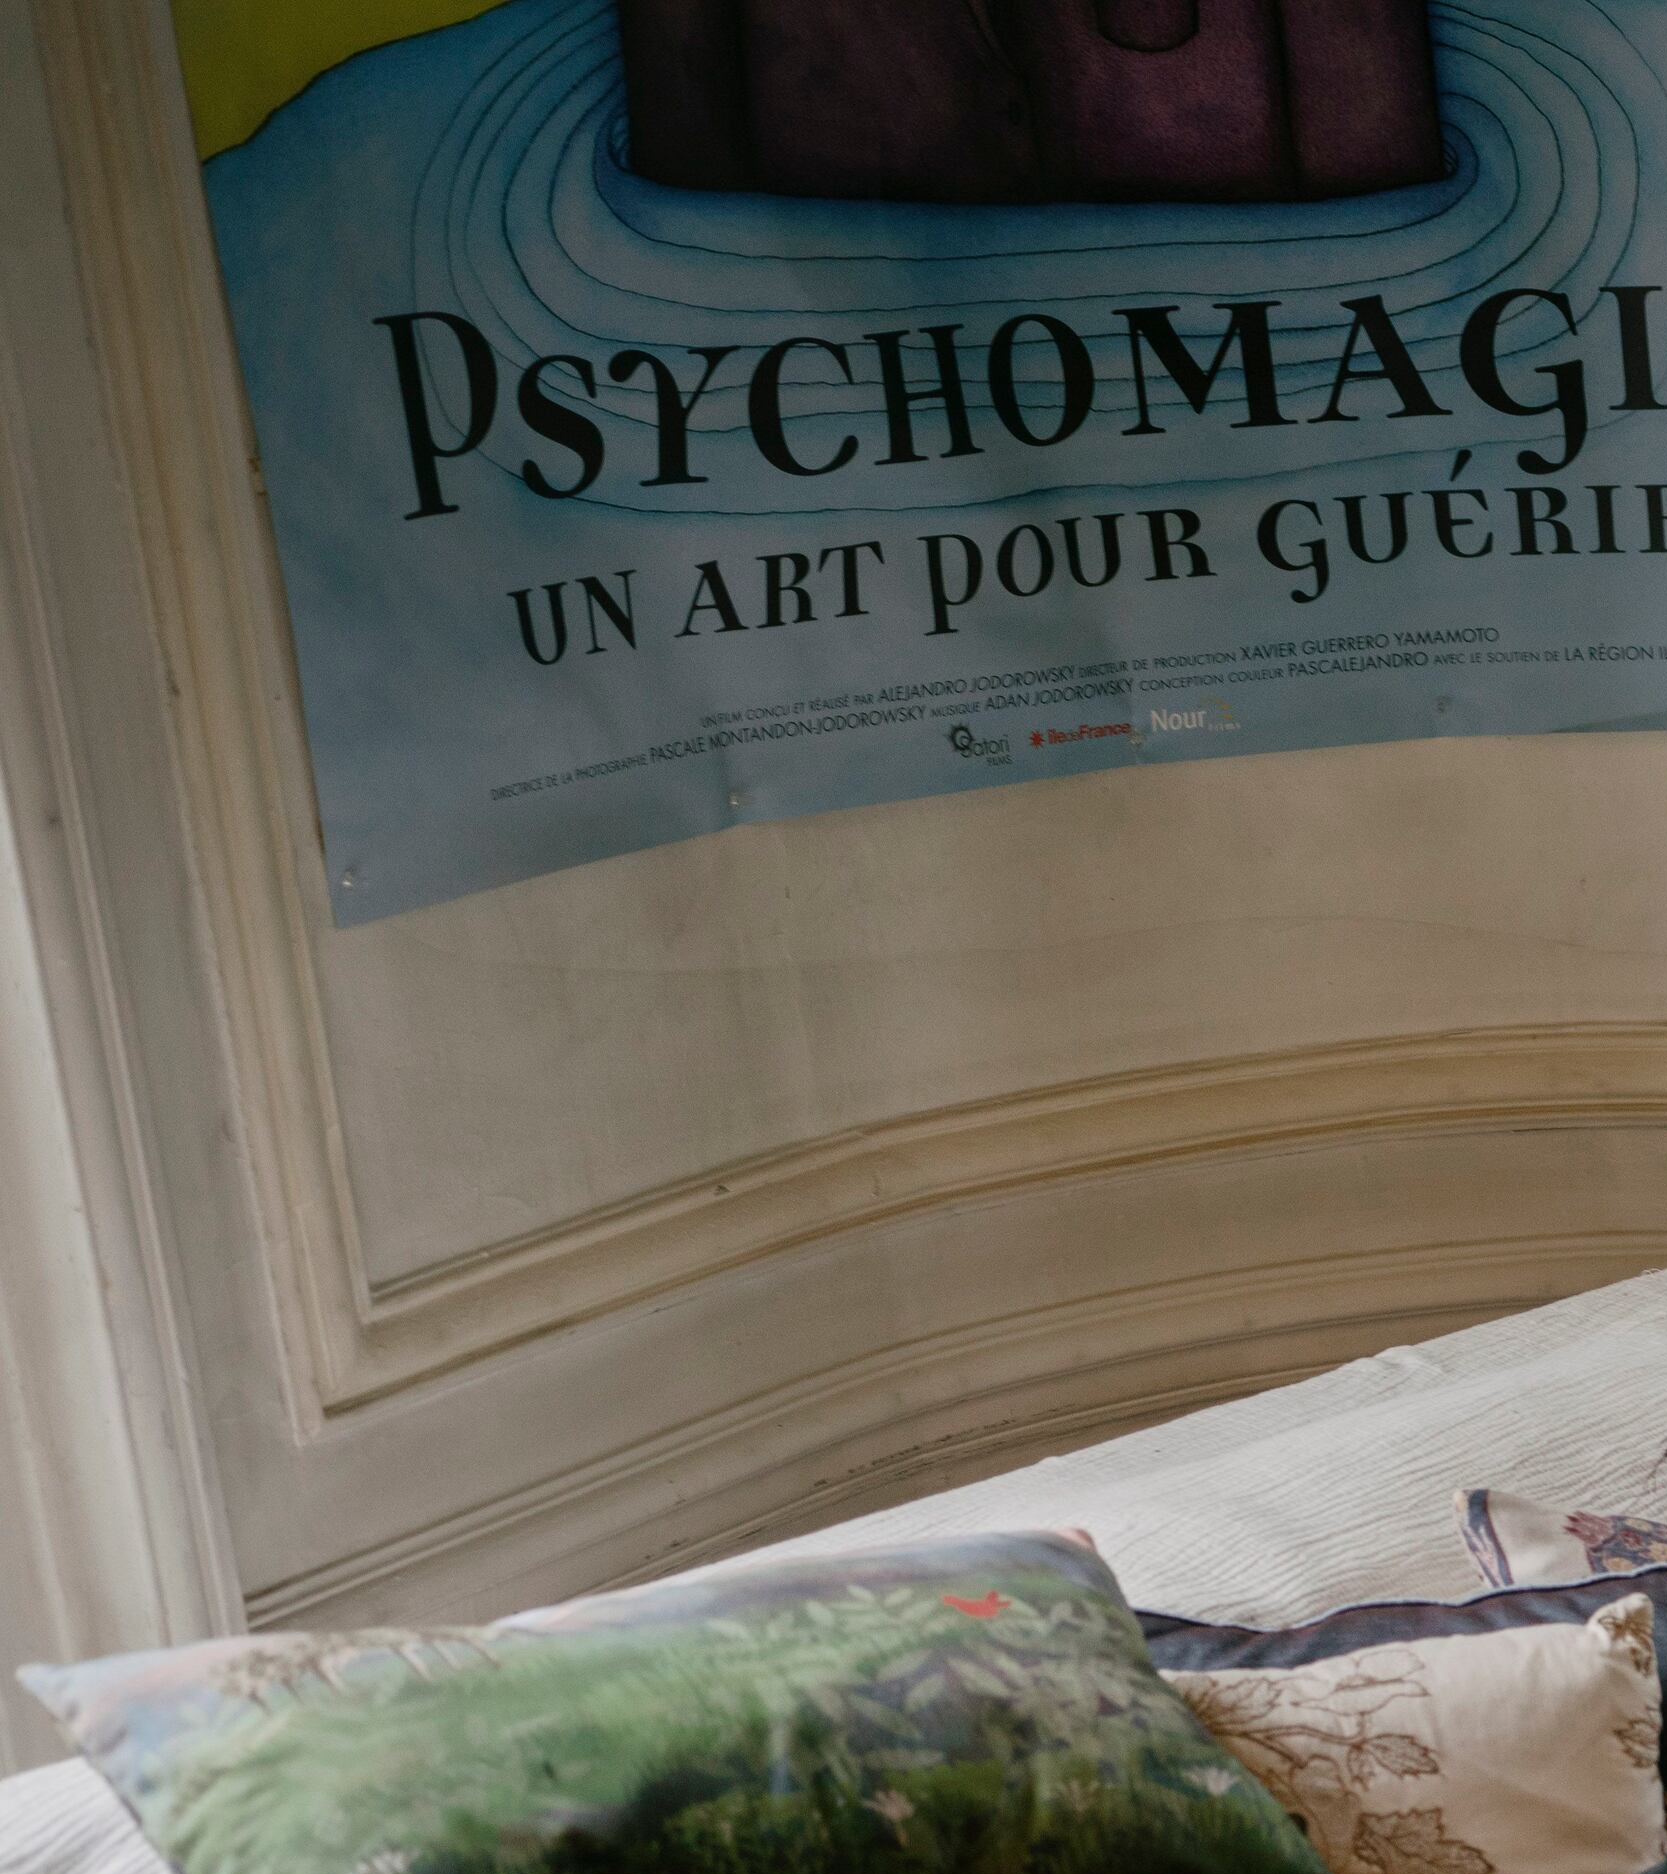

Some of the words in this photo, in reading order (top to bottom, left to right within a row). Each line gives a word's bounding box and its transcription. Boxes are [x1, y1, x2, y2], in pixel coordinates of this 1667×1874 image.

[506, 570, 638, 666] UN
[674, 541, 884, 638] ART
[918, 507, 1217, 635] POUR
[649, 735, 706, 764] PASCALE
[708, 706, 926, 748] MONTANDON-JODOROWSKY
[984, 693, 1031, 712] ADAN
[1031, 676, 1134, 708] JODOROWSKY
[1139, 674, 1225, 693] CONCEPTION
[1228, 667, 1285, 684] COULEUR
[1287, 650, 1430, 678] PASCALEJANDRO
[1432, 652, 1466, 666] AVEC
[1469, 651, 1482, 664] LE
[1486, 649, 1540, 665] SOUTIEN
[1543, 649, 1562, 663] DE
[1563, 646, 1585, 662] LA
[1588, 641, 1654, 662] RÉGION
[854, 693, 874, 706] PAR
[878, 678, 966, 703] ALEJANDRO
[968, 663, 1077, 693] JODOROWSKY
[1078, 659, 1128, 679] DIRECTEUR
[1132, 658, 1149, 671] DE
[1153, 650, 1236, 671] PRODUCTION
[1238, 640, 1297, 662] XAVIER
[1301, 632, 1390, 656] GUERRERO
[1392, 625, 1500, 650] YAMAMOTO
[1151, 710, 1208, 734] Nour
